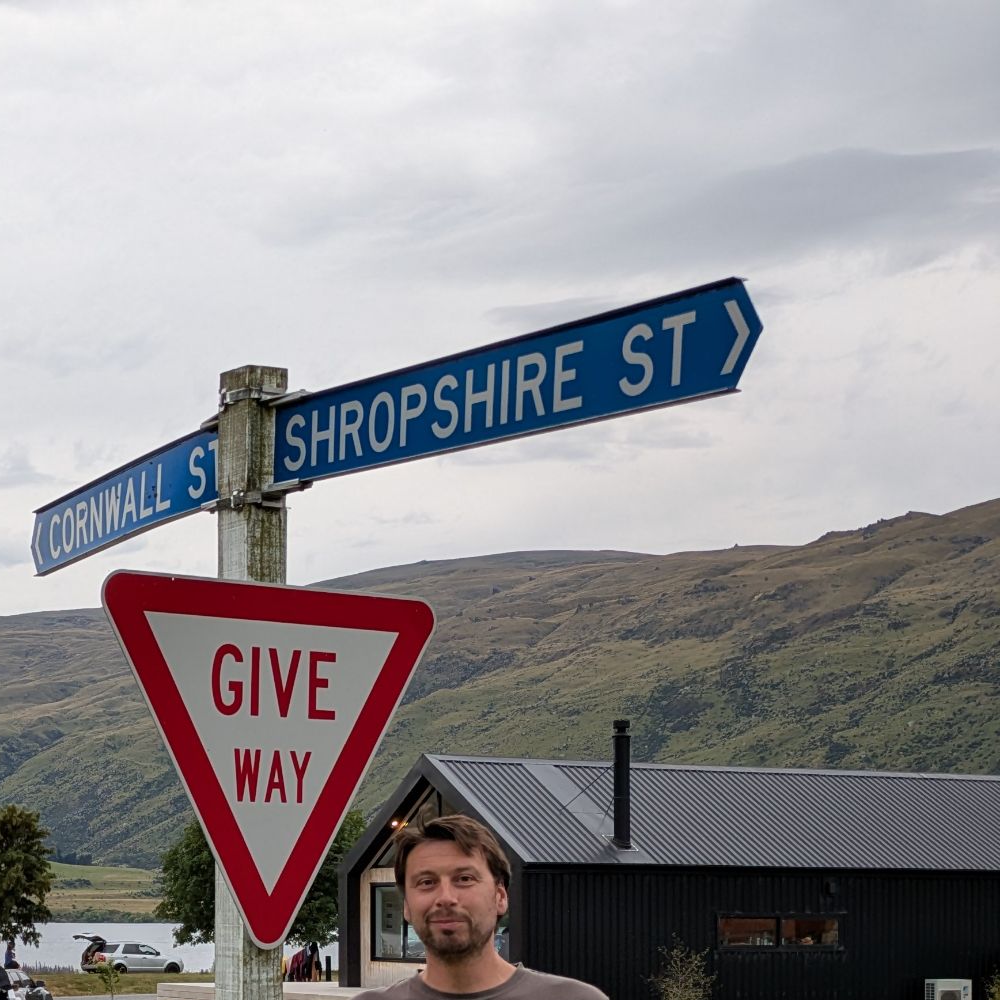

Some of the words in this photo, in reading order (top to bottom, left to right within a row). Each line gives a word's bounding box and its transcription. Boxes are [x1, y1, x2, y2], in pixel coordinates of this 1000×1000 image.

[283, 340, 584, 472] SHROPSHIRE
[618, 310, 697, 397] ST
[50, 463, 171, 560] CORNWALL
[211, 643, 337, 721] GIVE
[234, 747, 313, 804] WAY
